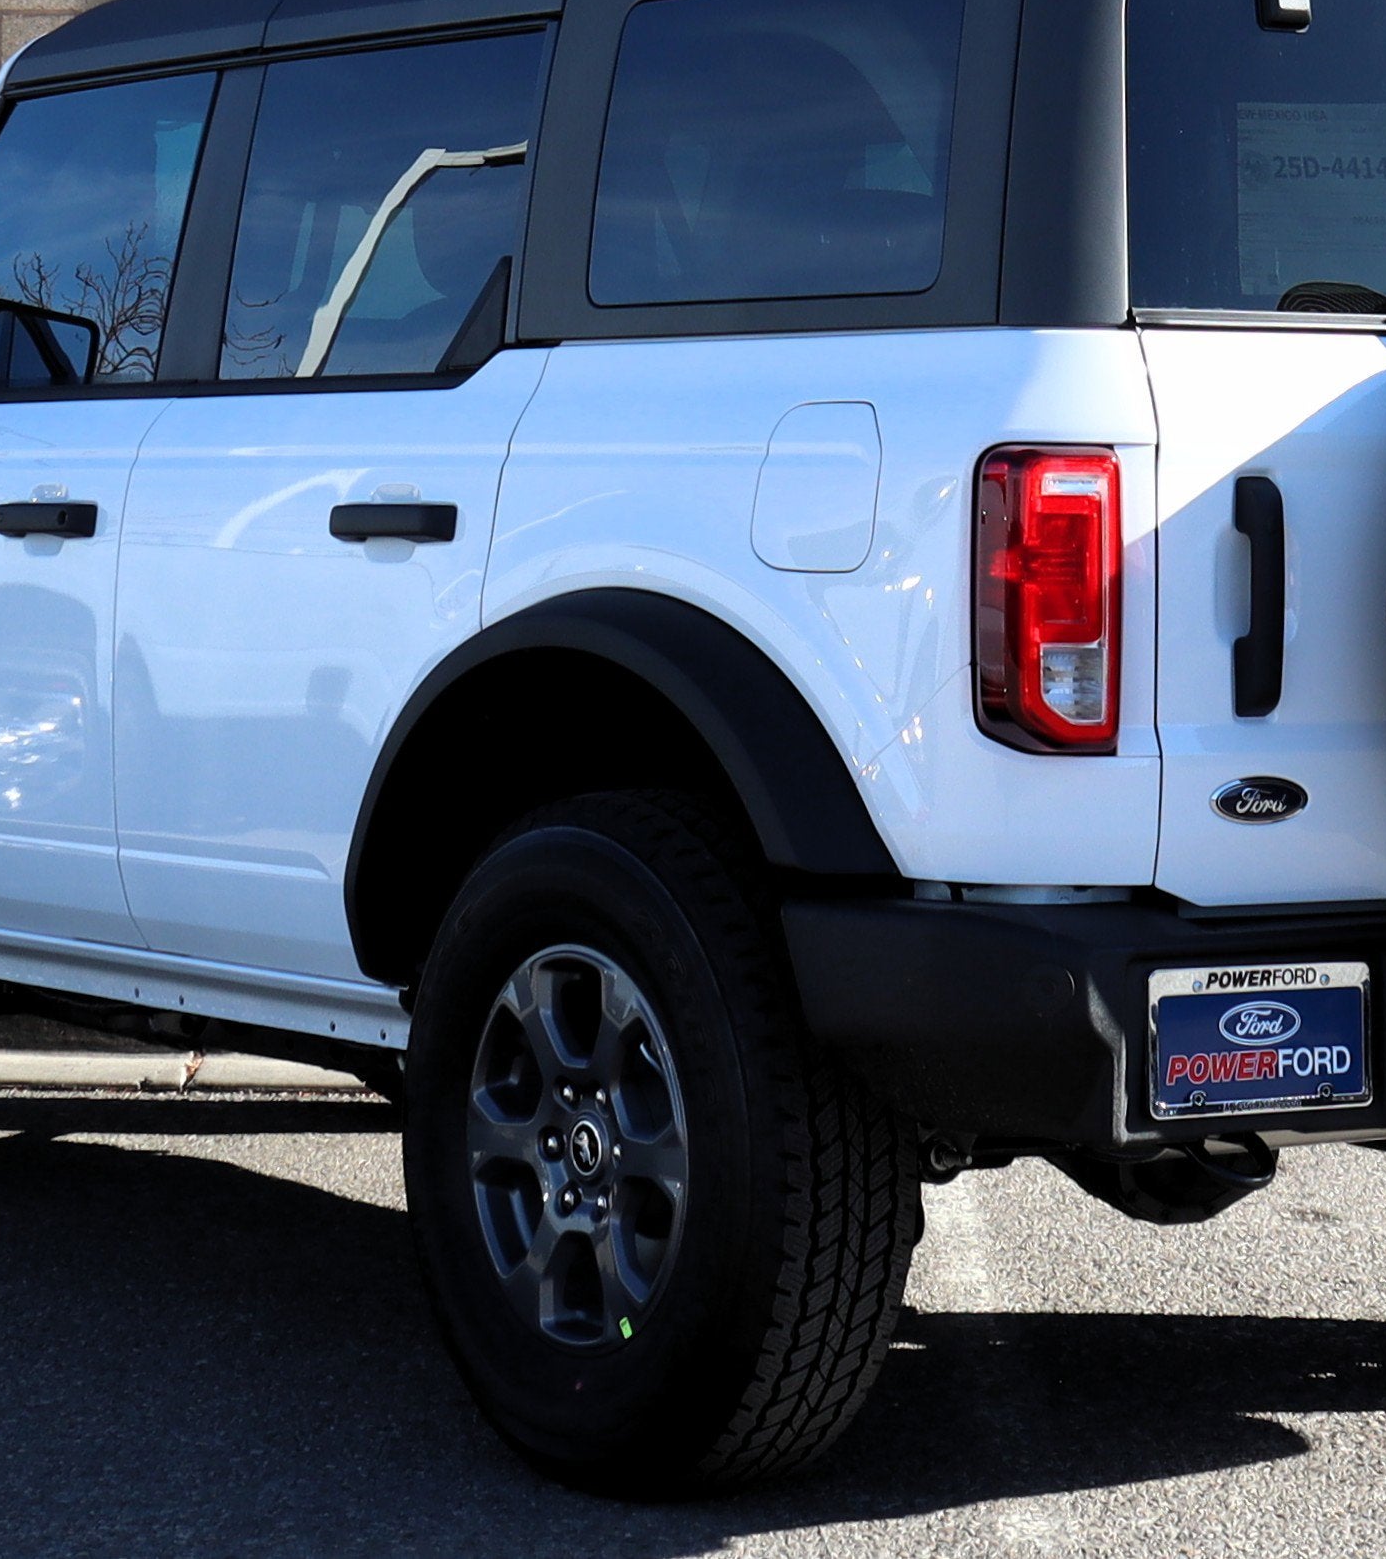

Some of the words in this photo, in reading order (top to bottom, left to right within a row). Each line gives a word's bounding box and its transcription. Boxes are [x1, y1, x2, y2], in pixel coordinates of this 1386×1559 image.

[1303, 110, 1328, 122] USA
[1235, 787, 1287, 814] Ford
[1205, 967, 1317, 990] POWERFORD
[1235, 1009, 1284, 1036] Ford
[1166, 1045, 1351, 1086] POWERFORD
